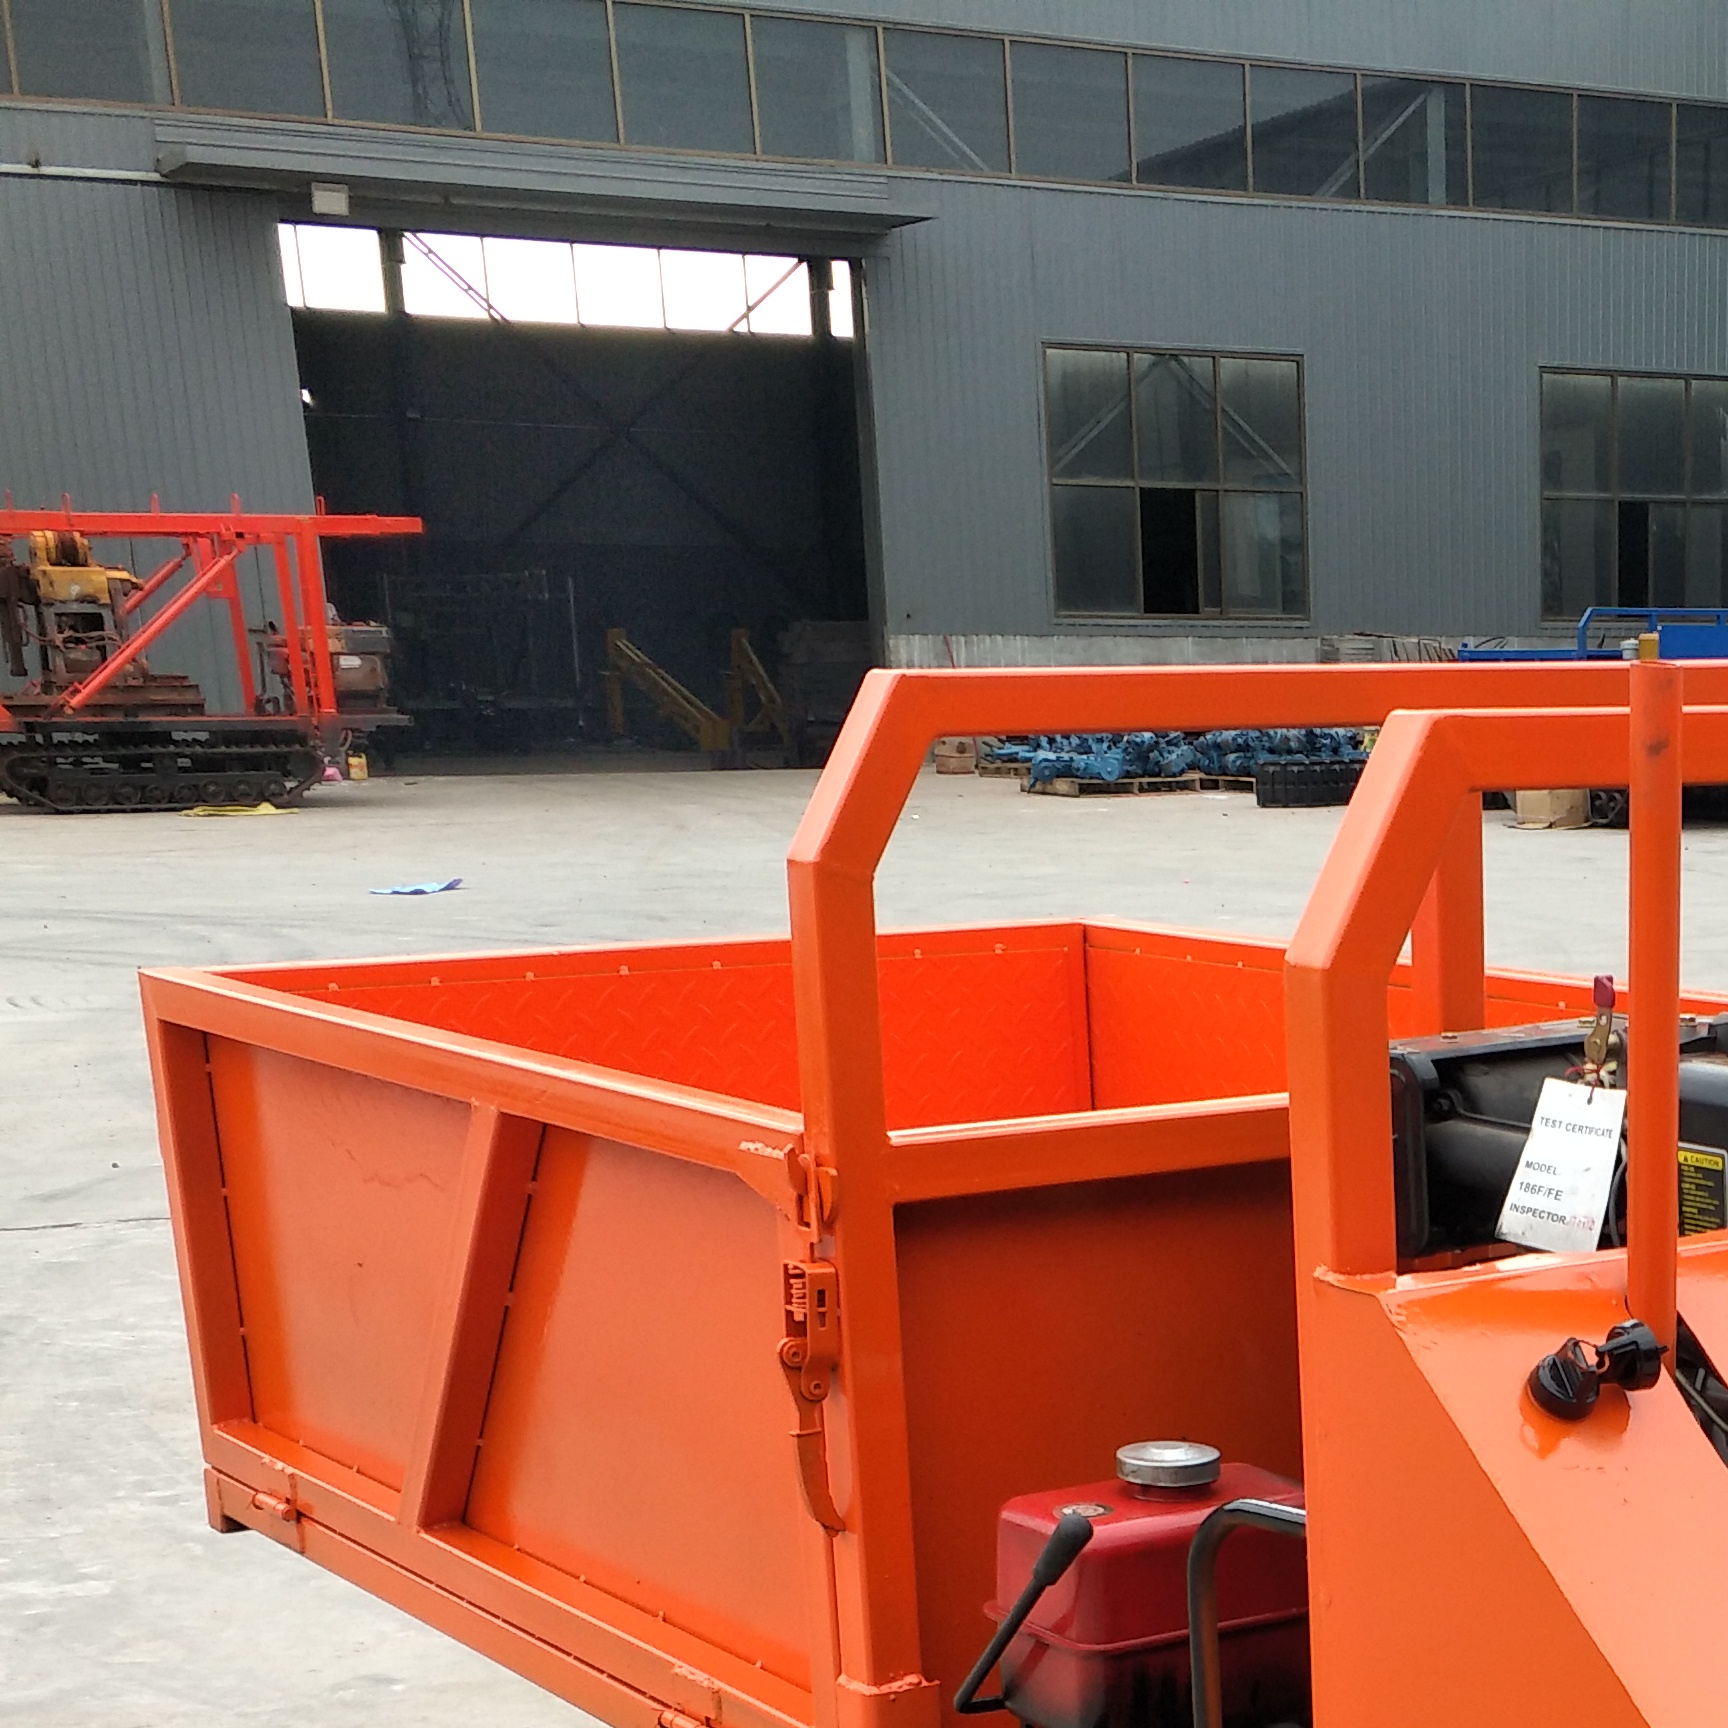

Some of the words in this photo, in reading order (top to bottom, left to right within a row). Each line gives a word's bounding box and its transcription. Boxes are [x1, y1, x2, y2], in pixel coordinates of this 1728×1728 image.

[1540, 1116, 1564, 1130] TEST
[1565, 1122, 1614, 1139] CERTIFICATE
[1518, 1181, 1564, 1202] 186F/FE
